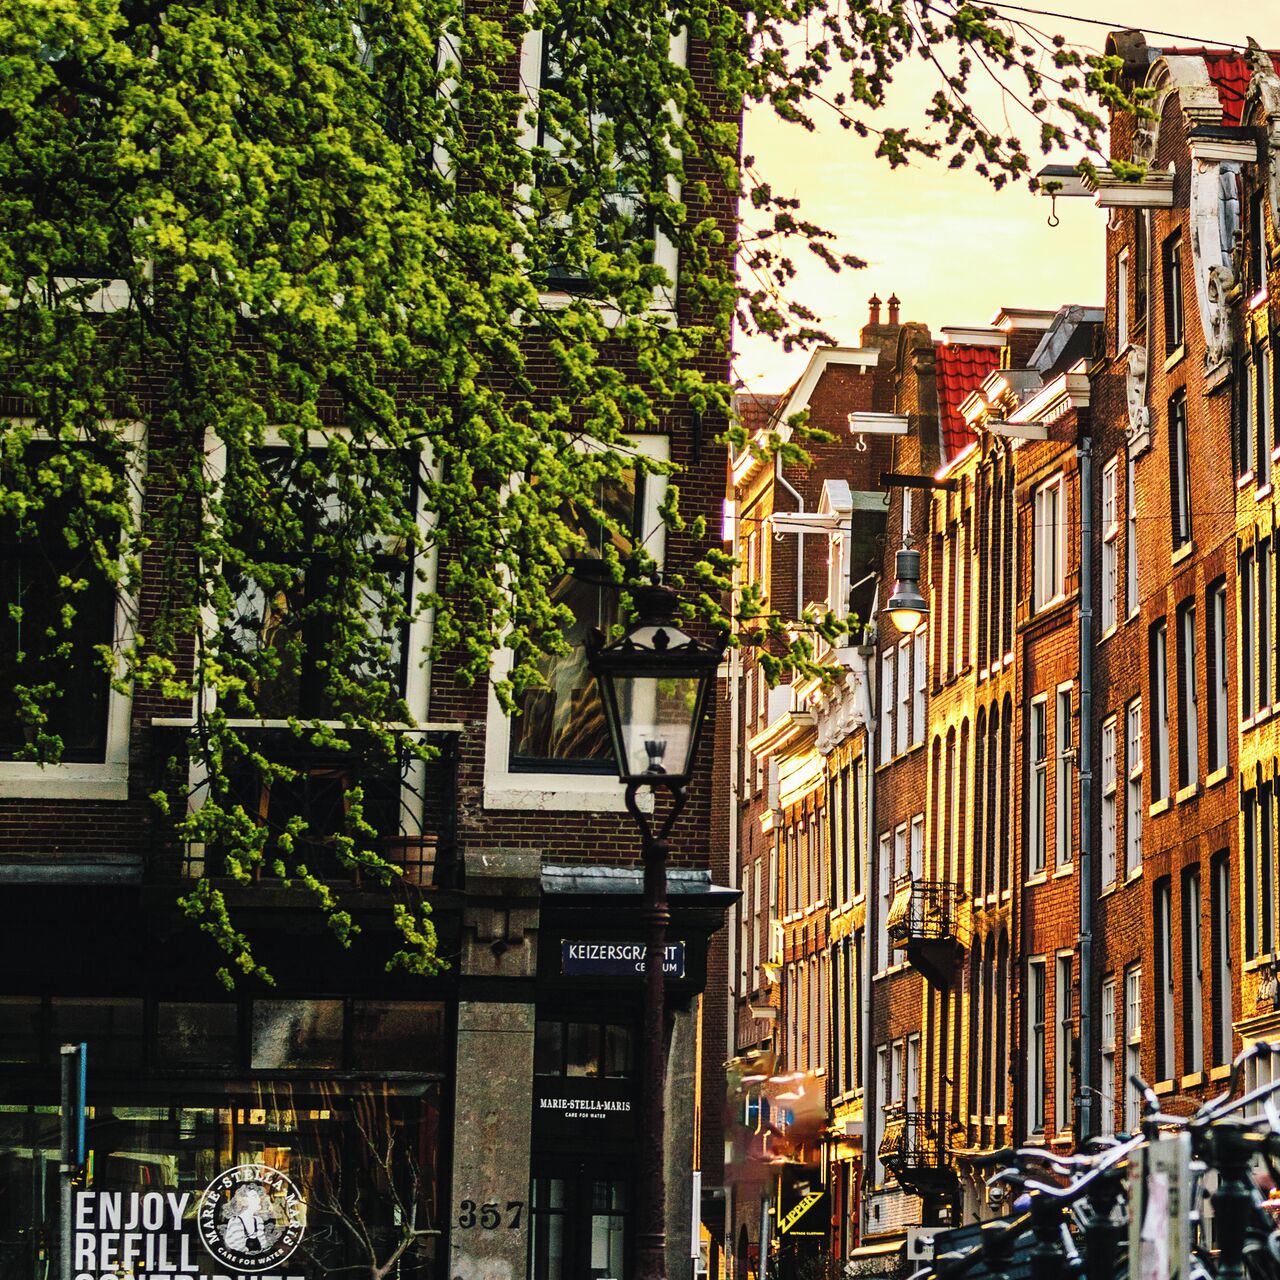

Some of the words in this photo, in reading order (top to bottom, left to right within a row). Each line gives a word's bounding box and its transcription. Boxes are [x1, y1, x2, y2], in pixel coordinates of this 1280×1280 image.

[635, 962, 677, 972] CEUM
[540, 1099, 631, 1111] MARIE-STELLA-MARIS
[76, 1191, 190, 1231] ENJOY
[459, 1200, 524, 1230] 357
[778, 1192, 825, 1234] ZIPPER
[75, 1233, 199, 1271] REFILL
[218, 1247, 237, 1262] CARE
[258, 1248, 284, 1264] WATER
